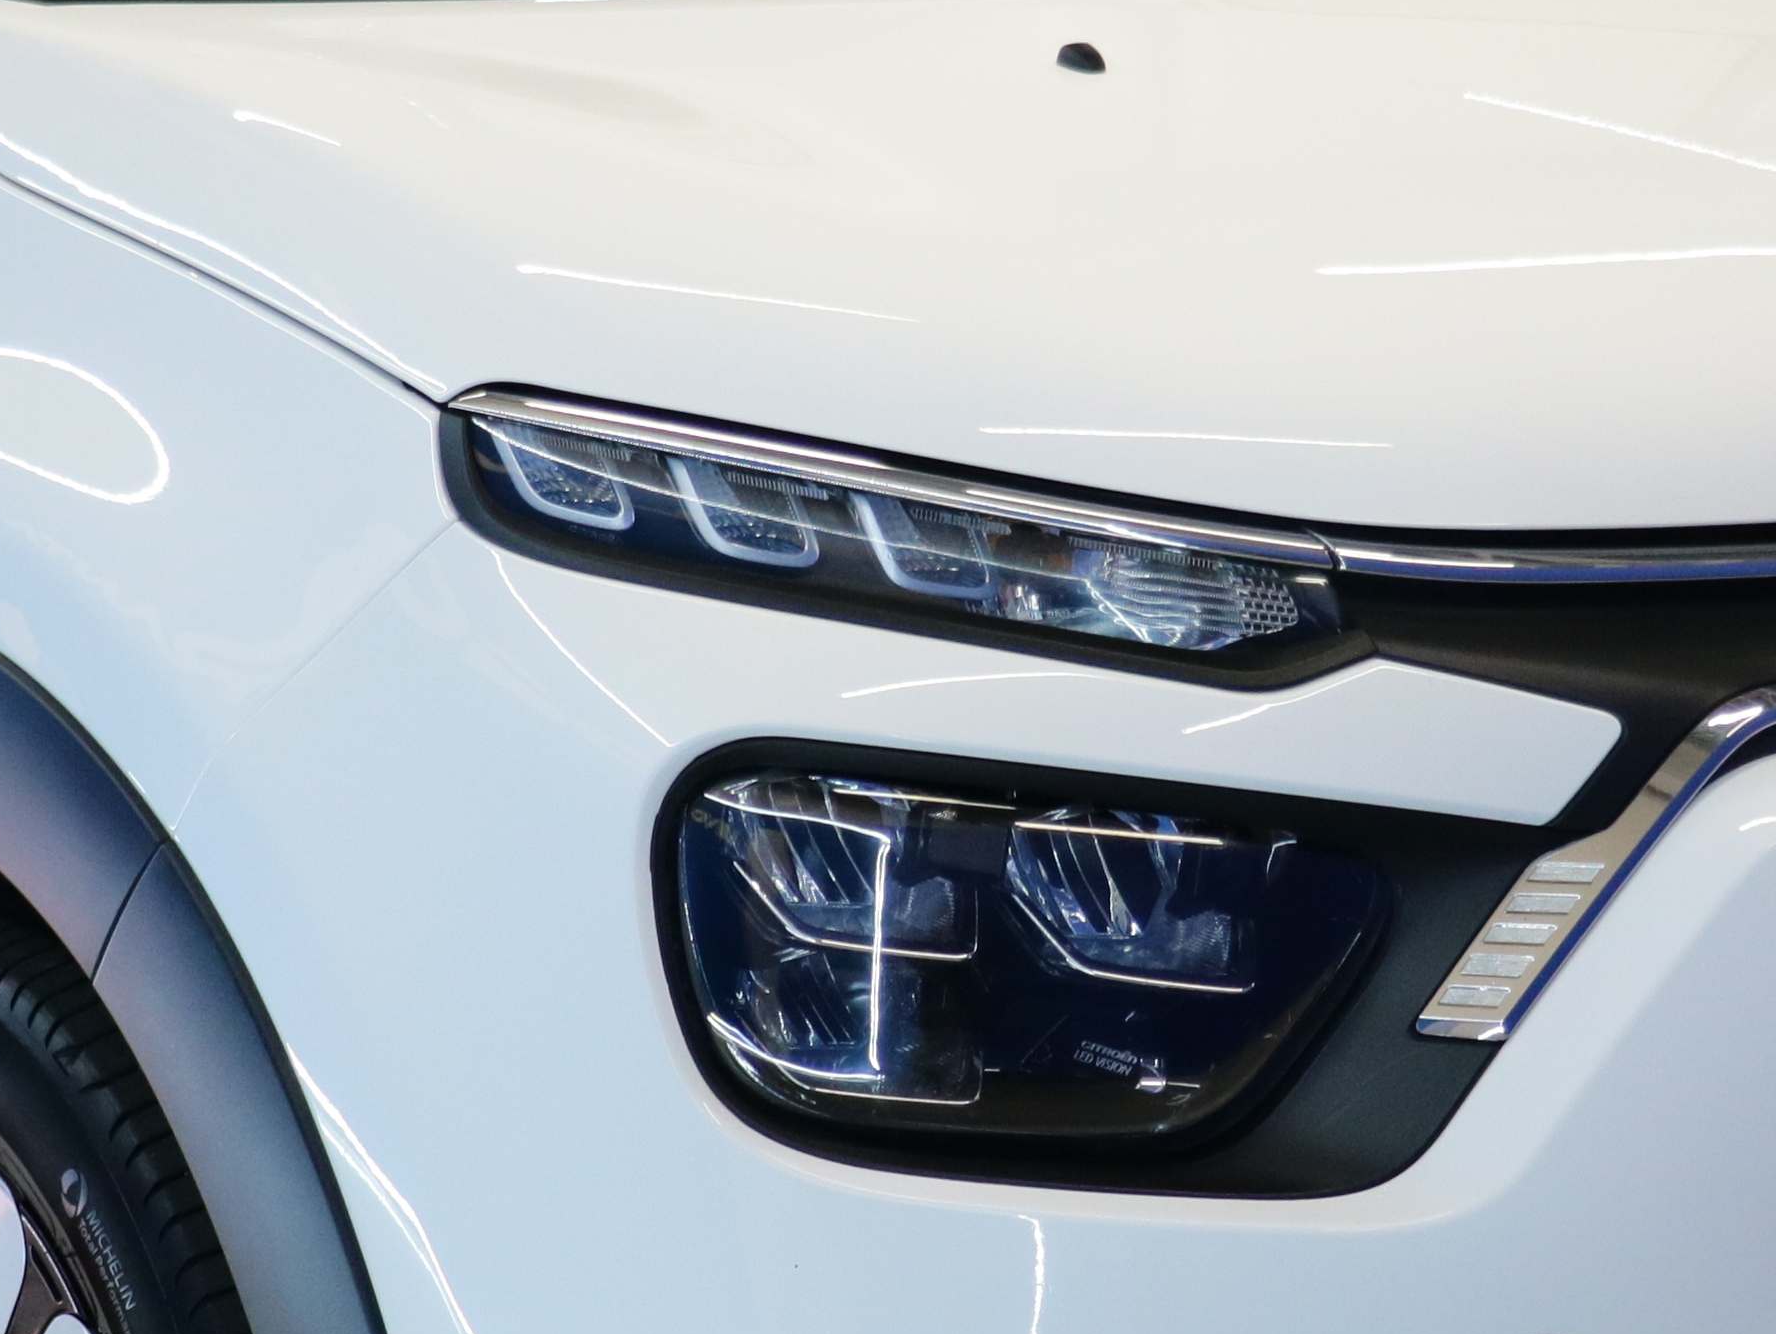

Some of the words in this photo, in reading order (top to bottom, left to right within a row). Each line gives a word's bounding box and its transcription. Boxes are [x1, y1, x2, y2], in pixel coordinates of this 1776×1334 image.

[1074, 1049, 1094, 1064] LED
[1095, 1055, 1133, 1077] VISION
[78, 1217, 99, 1256] Total
[86, 1209, 137, 1311] MICHELIN
